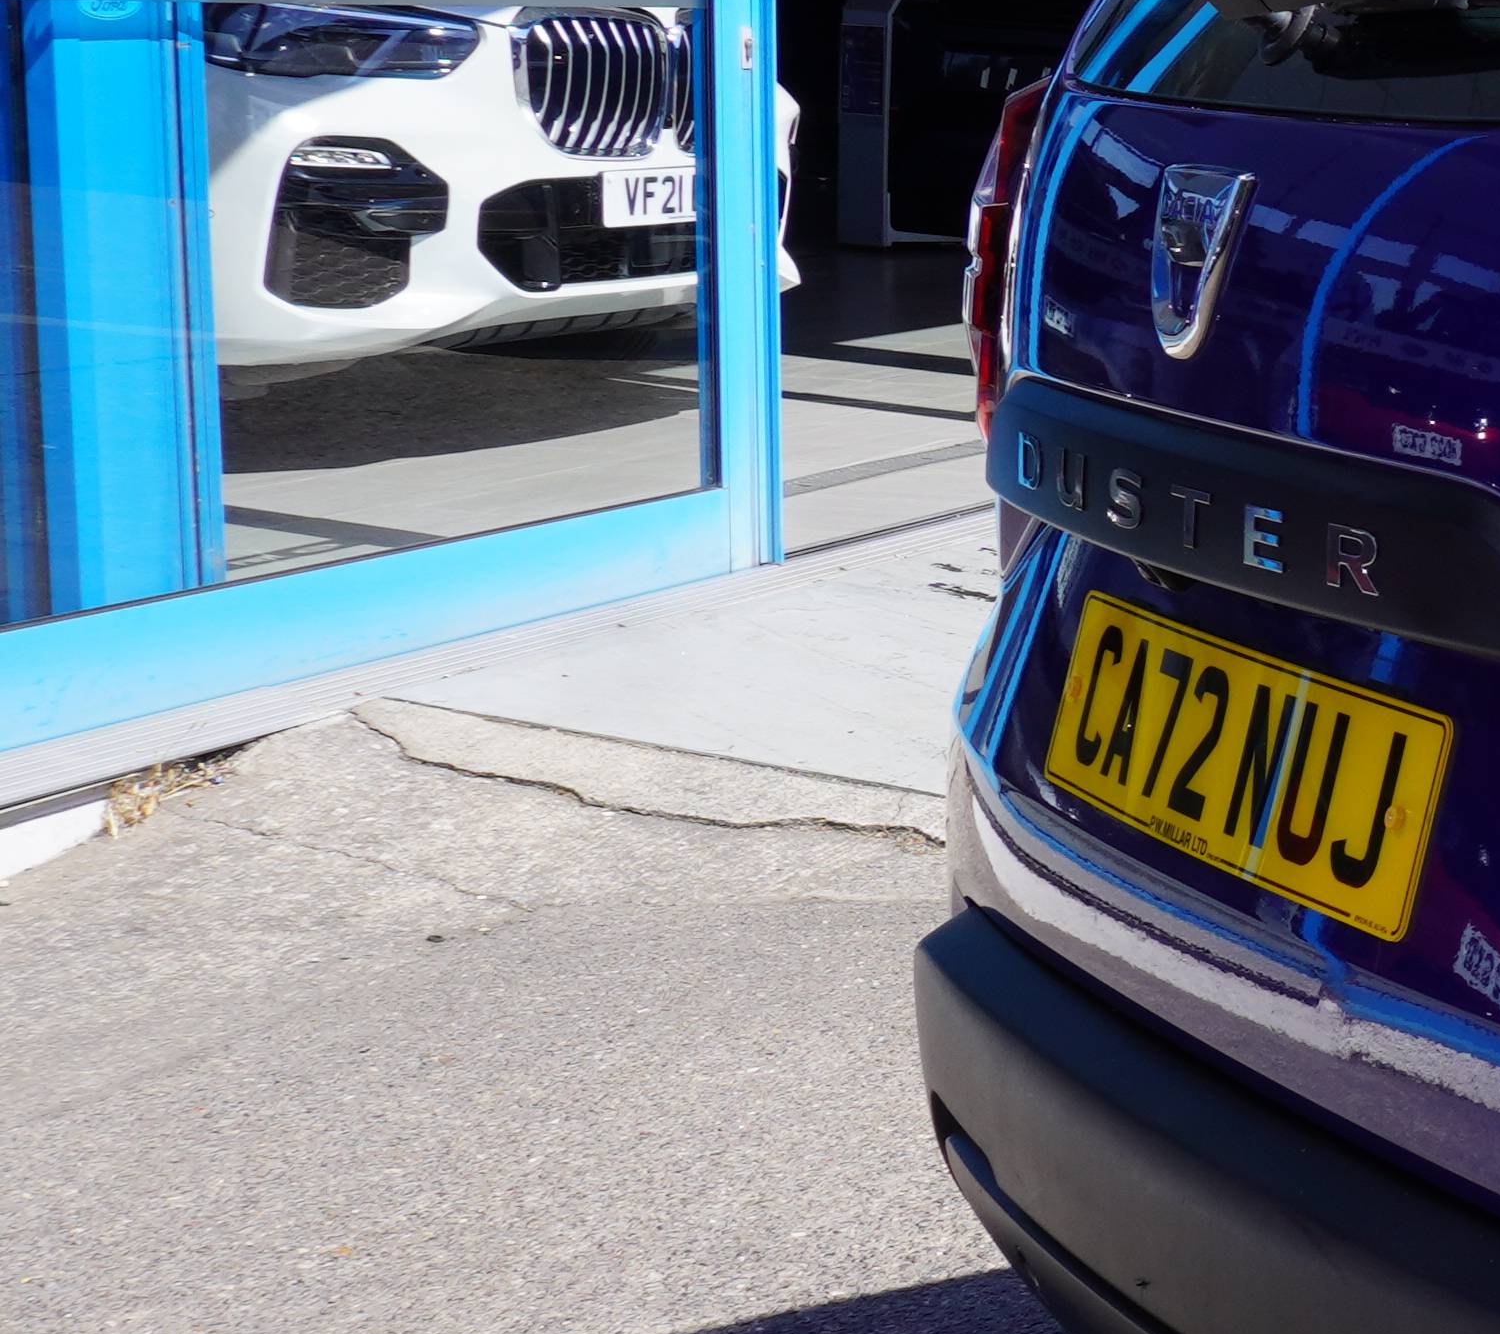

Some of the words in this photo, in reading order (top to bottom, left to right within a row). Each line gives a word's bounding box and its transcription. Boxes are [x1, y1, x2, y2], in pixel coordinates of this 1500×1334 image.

[1016, 430, 1380, 597] DUSTER
[1074, 624, 1230, 822] CA72
[1223, 682, 1408, 889] NUJ
